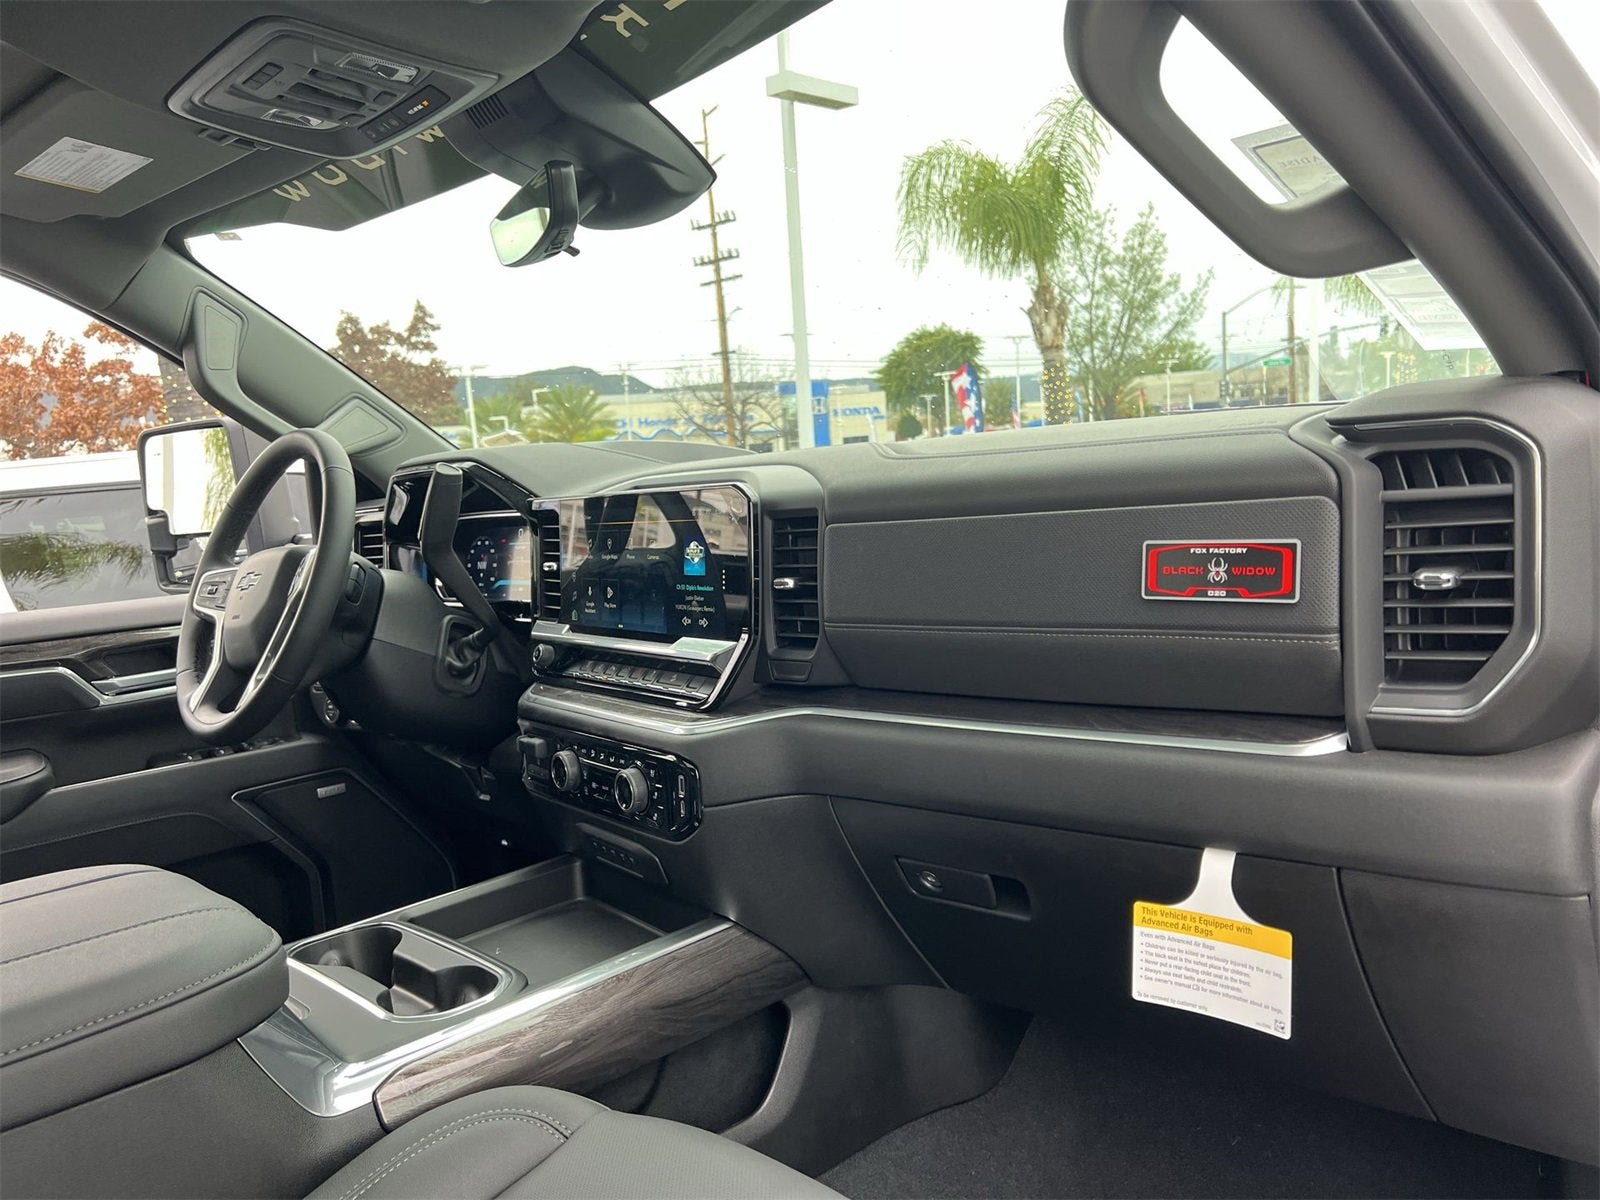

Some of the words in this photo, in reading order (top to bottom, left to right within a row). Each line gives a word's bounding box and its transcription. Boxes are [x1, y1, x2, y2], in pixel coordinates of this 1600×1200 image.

[832, 405, 880, 417] HONDA
[1162, 566, 1204, 575] BLACK
[1231, 567, 1276, 575] WIDOW
[1142, 906, 1157, 917] This
[1160, 909, 1187, 922] Vehicle
[1190, 915, 1197, 924] is
[1199, 917, 1234, 933] Equipped
[1236, 924, 1252, 935] with
[1142, 915, 1179, 930] Advanced
[1182, 923, 1192, 932] Air
[1194, 926, 1214, 937] Bags
[1167, 936, 1192, 946] Advanced
